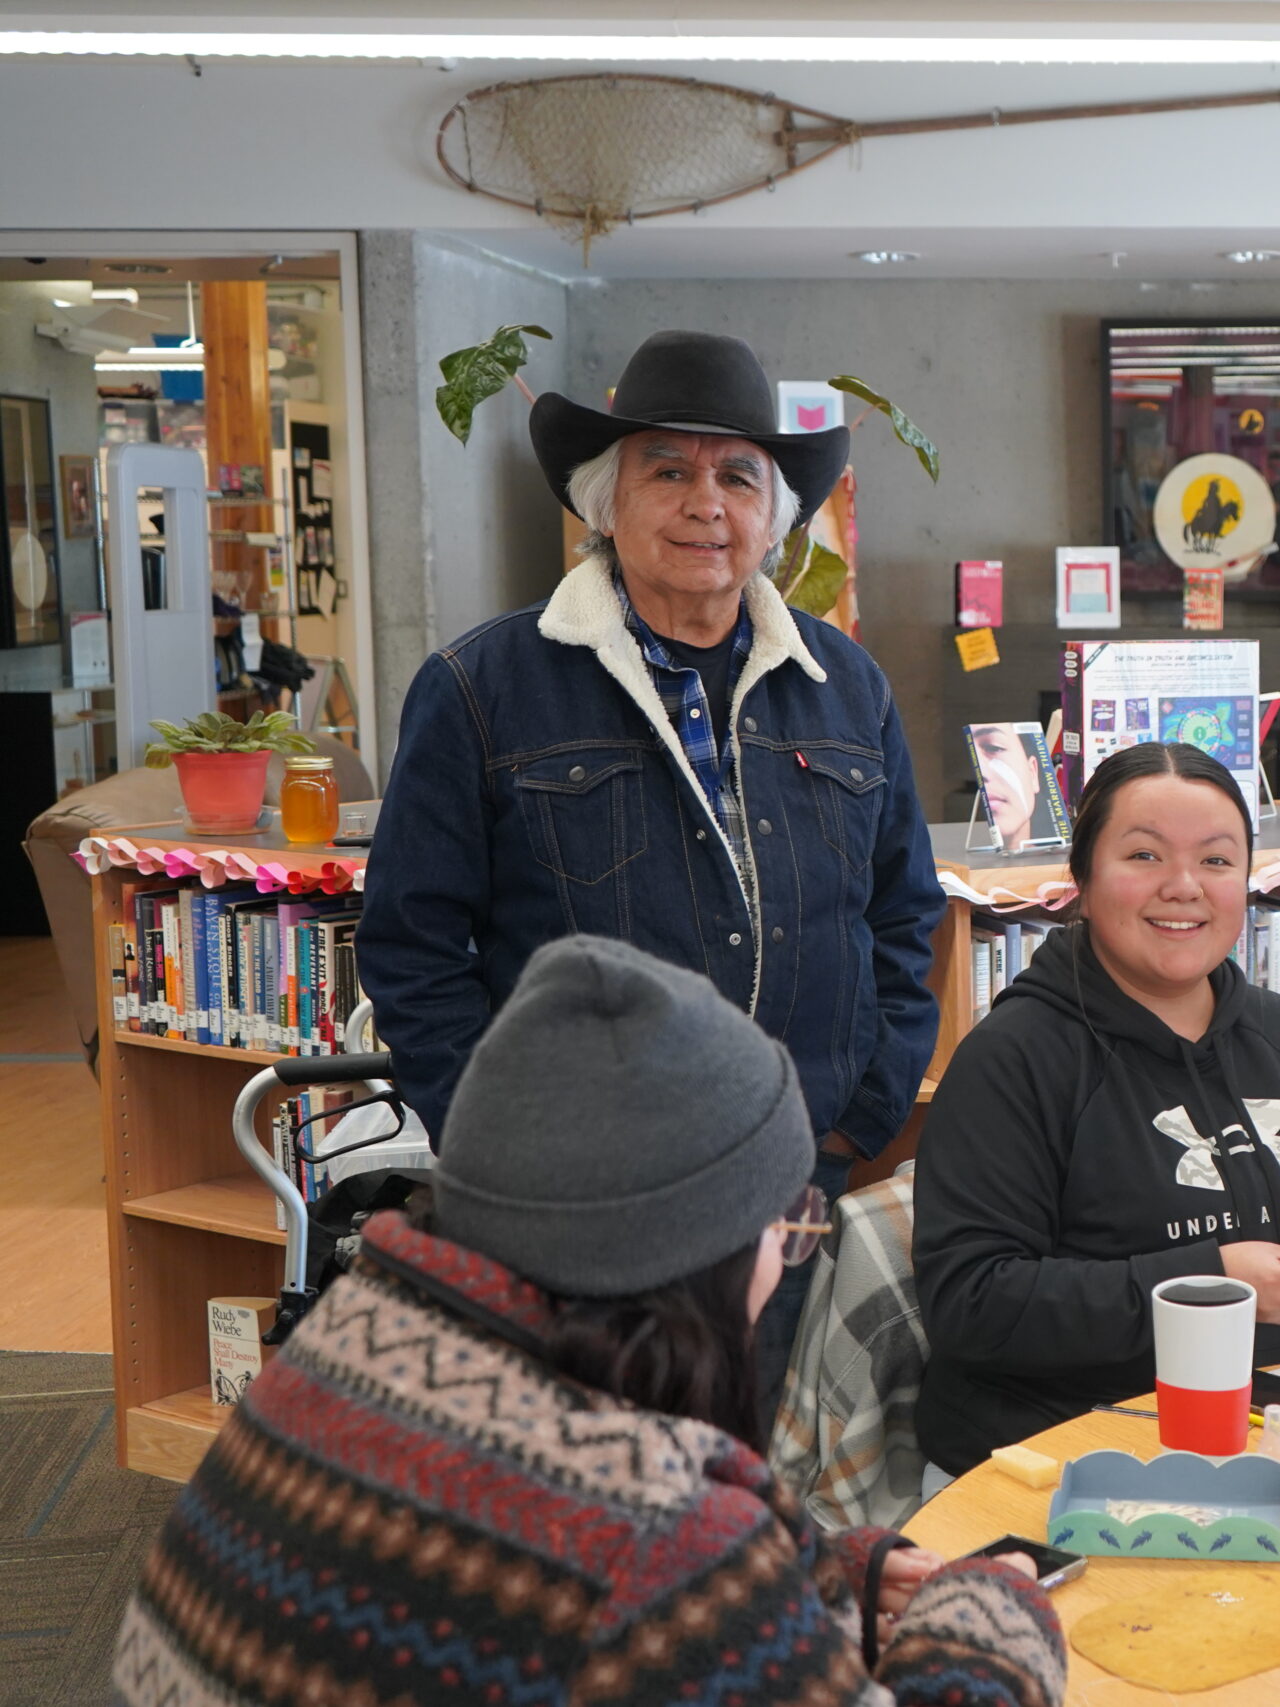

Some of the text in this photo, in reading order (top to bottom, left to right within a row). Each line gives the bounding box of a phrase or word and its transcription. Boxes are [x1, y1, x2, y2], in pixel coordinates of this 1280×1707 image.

[1032, 732, 1070, 839] THE MARROW THIEVE
[318, 929, 326, 951] FIRE
[212, 1306, 236, 1322] Rudy
[212, 1320, 242, 1336] Wiebe
[231, 1350, 258, 1364] Destroy
